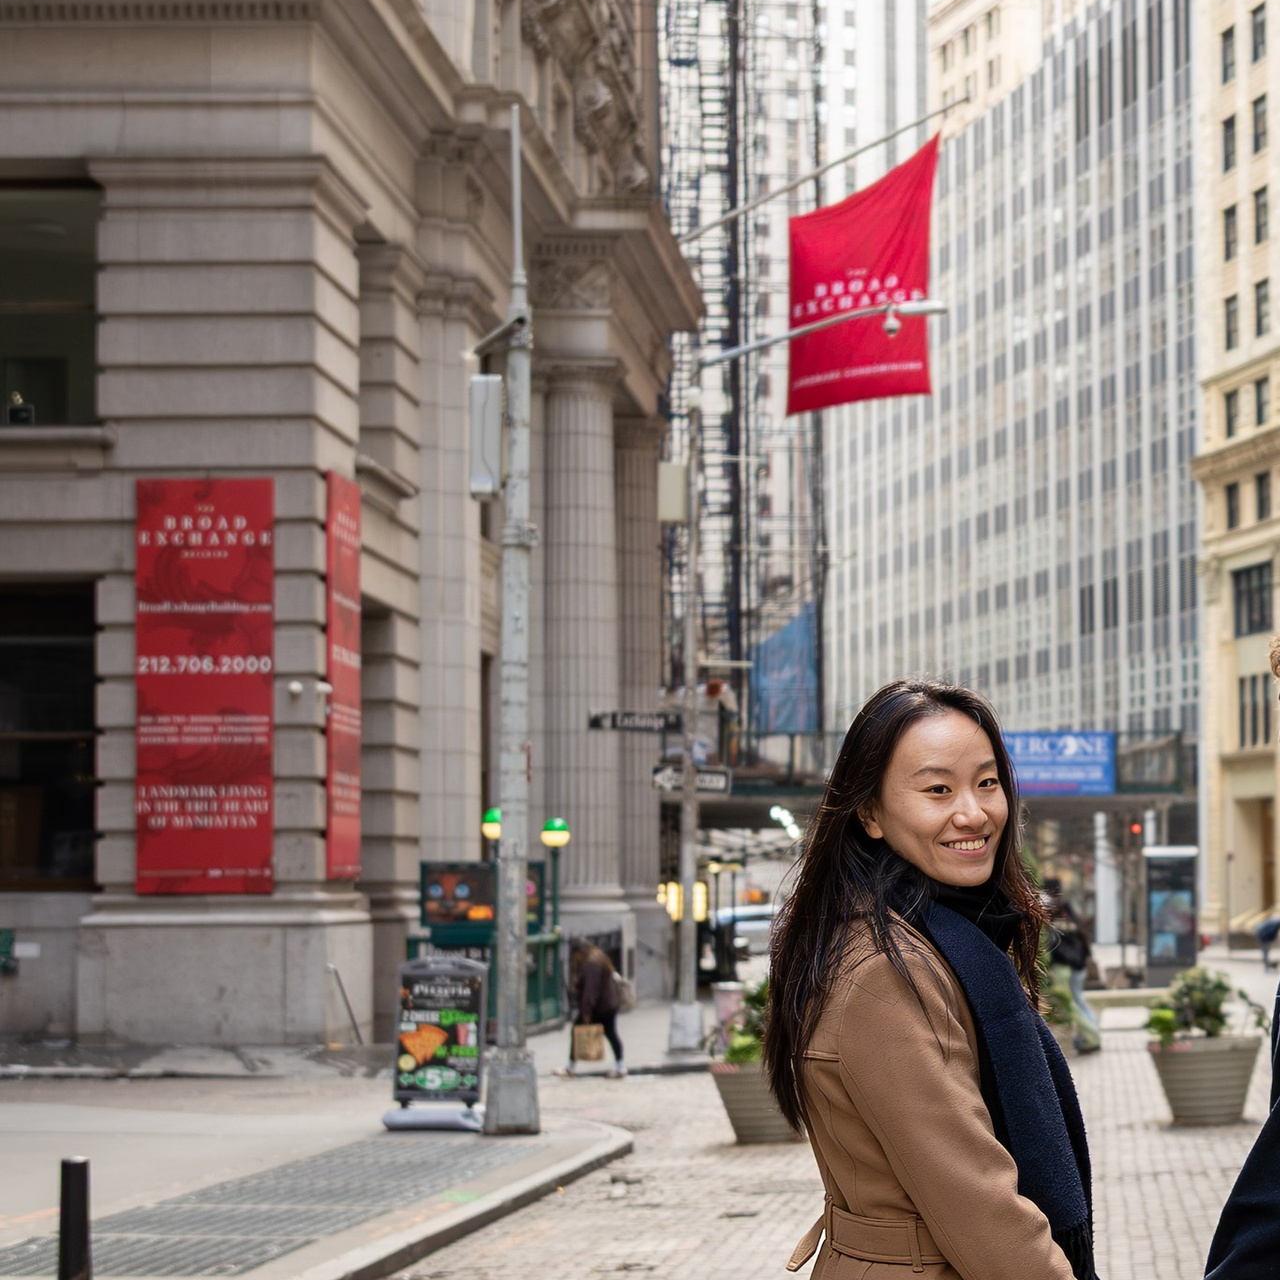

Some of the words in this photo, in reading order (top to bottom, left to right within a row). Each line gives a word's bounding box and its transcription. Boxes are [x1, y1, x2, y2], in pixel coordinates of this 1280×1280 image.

[814, 275, 899, 298] BROAD
[793, 289, 923, 318] EXCHANGE
[164, 516, 248, 531] BROAD
[138, 531, 273, 547] EXCHANGE
[138, 655, 273, 674] 212.706.2000
[139, 785, 218, 799] LANDMARK
[220, 785, 268, 799] LIVING
[222, 800, 269, 814] HEART
[149, 815, 168, 829] OF
[171, 815, 258, 829] MANHATTAN
